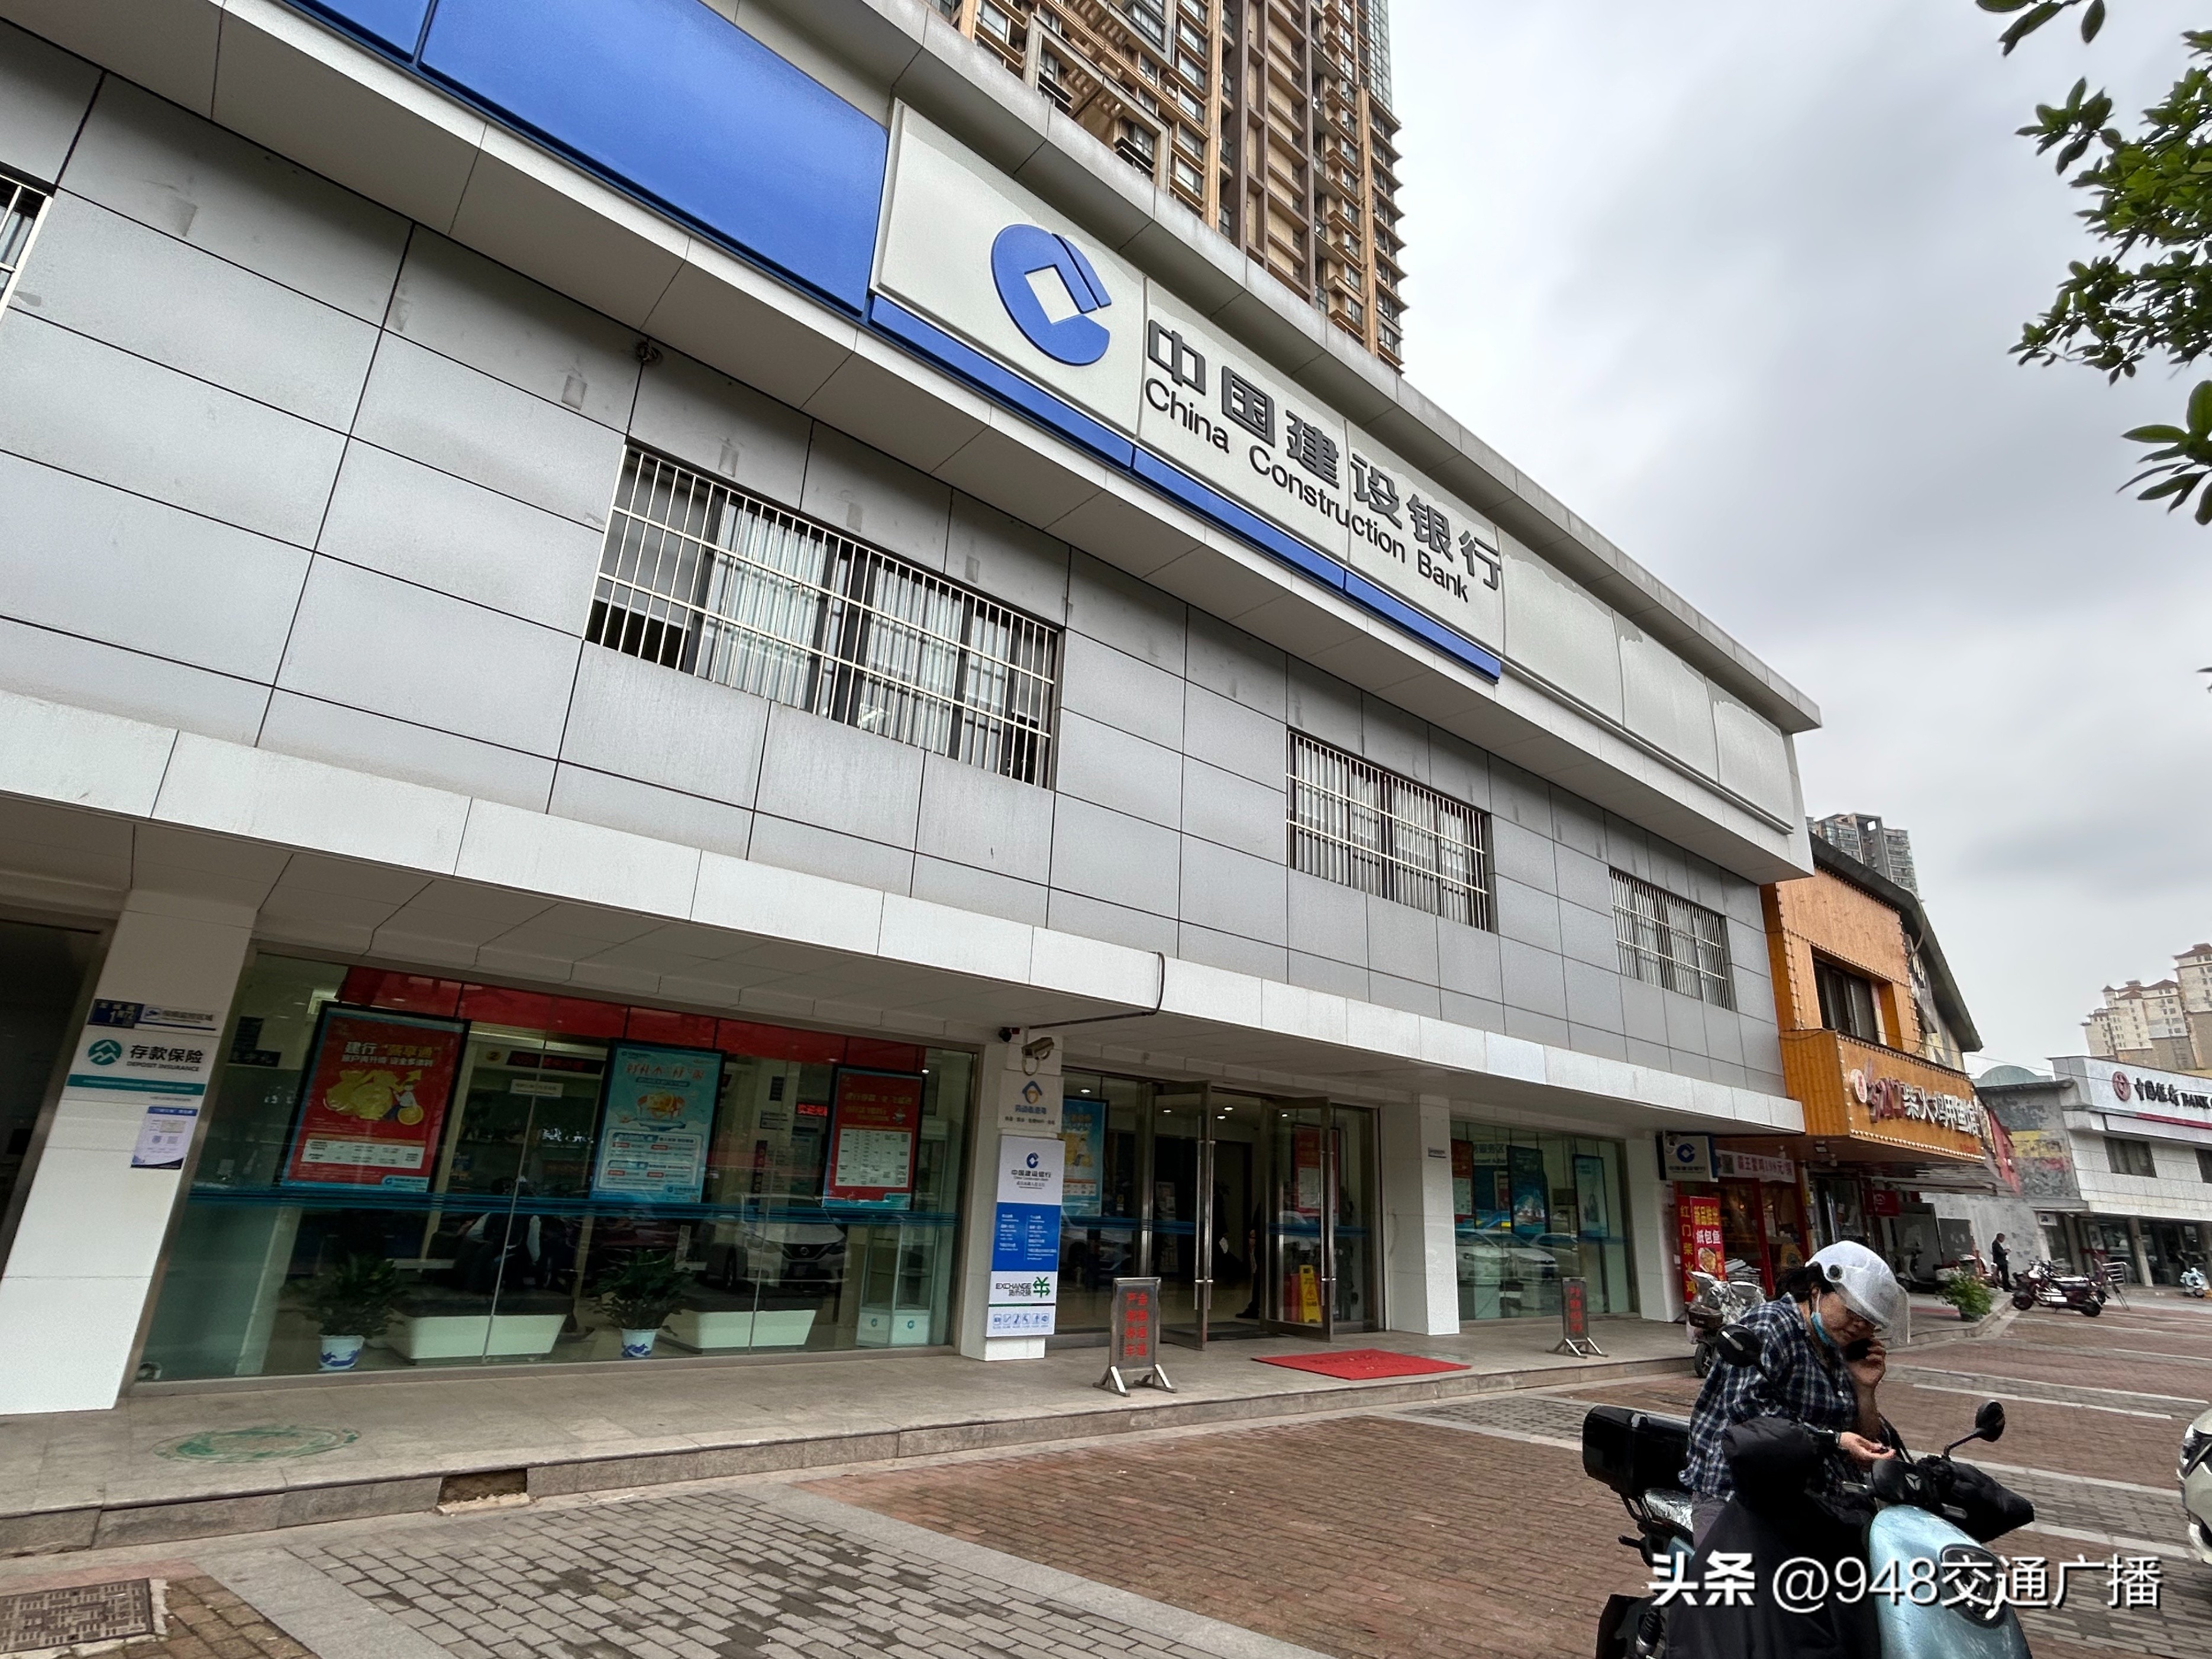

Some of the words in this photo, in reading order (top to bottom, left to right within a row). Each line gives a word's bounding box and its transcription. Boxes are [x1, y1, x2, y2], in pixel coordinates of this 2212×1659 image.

[1148, 319, 1501, 591] 中国建设银行
[1145, 377, 1229, 454] China
[1249, 446, 1406, 563] Construction
[1417, 548, 1469, 602] Bank
[130, 1044, 204, 1064] 存款保险
[158, 1063, 199, 1072] INSURANCE
[2180, 1093, 2210, 1110] BANK
